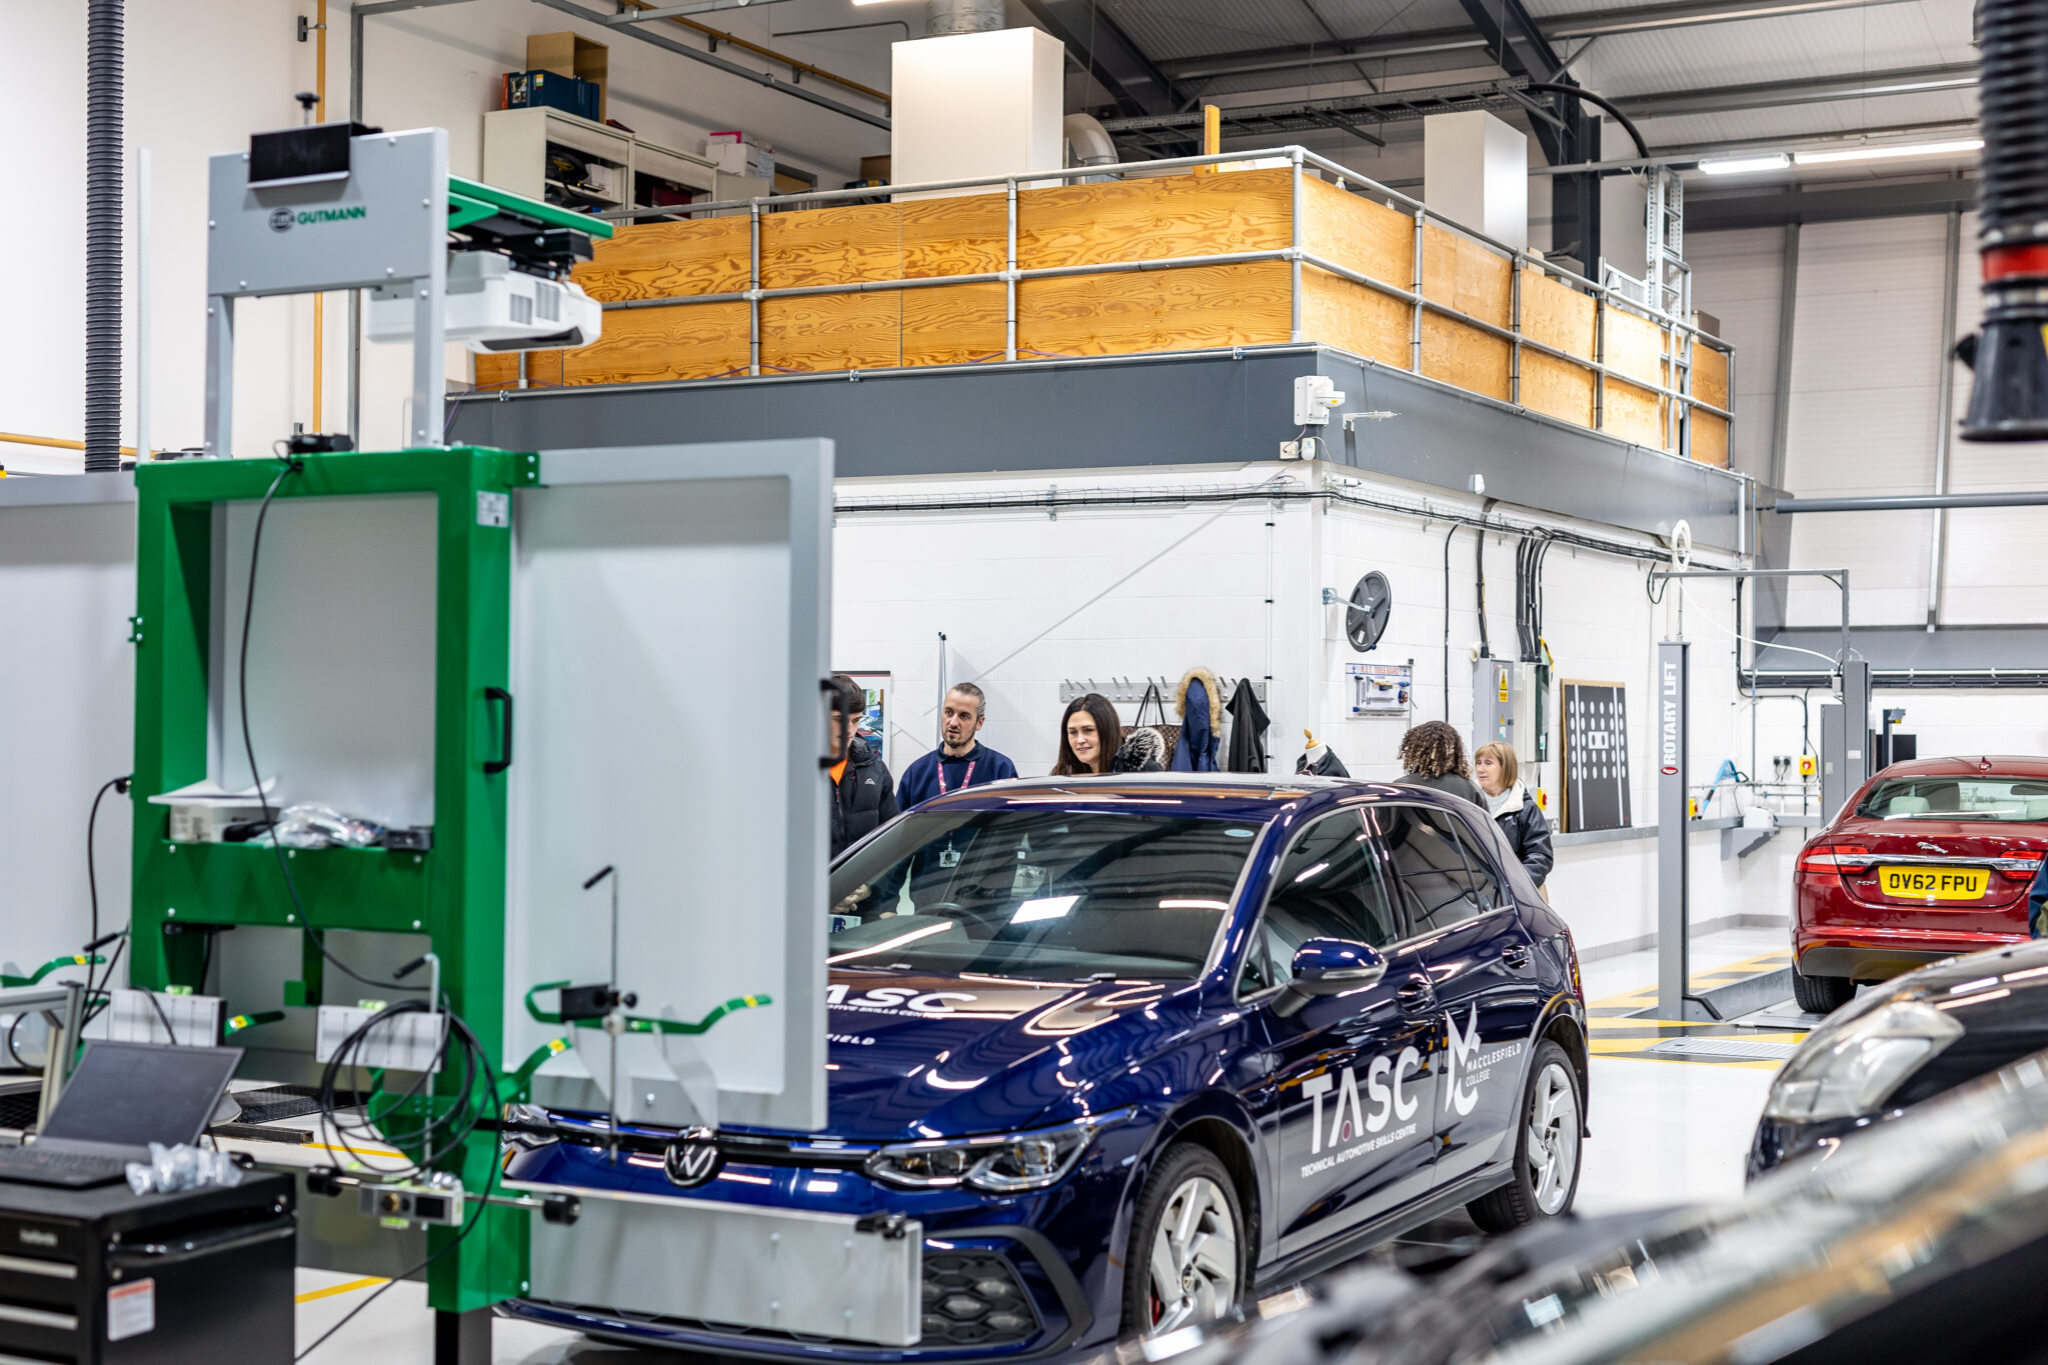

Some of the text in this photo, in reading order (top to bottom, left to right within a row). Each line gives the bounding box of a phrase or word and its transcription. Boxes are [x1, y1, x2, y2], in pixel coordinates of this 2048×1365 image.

[297, 206, 366, 225] GUTMANN
[1663, 661, 1676, 695] LIFT
[1663, 700, 1676, 765] ROTARY
[1889, 873, 1977, 892] OV62 FPU
[1466, 1043, 1522, 1073] MACCLESFIELD
[1465, 1068, 1491, 1087] COLLEGE
[1302, 1046, 1420, 1154] TASC
[1301, 1122, 1417, 1178] TECHNICAL AUTOMOTIVE SKILLS CENTRE
